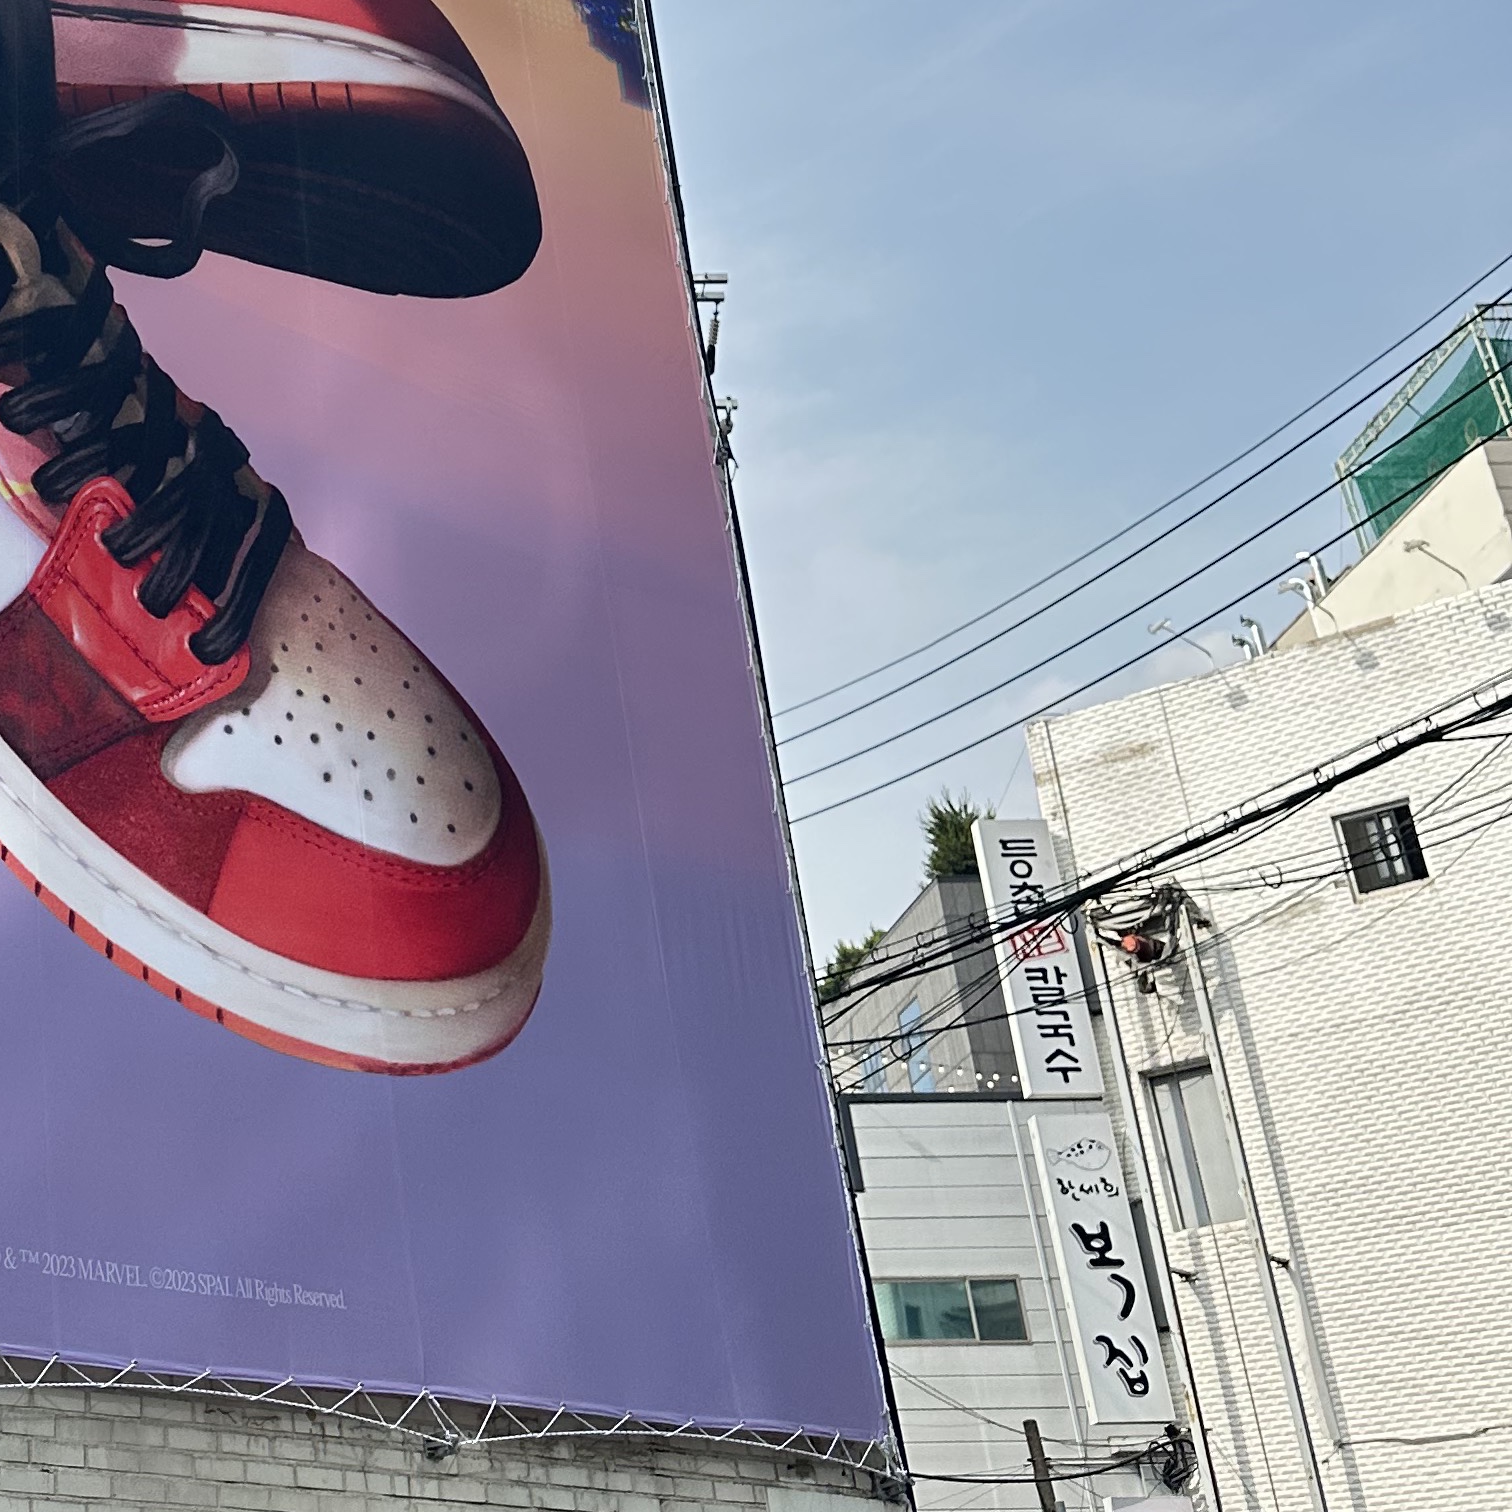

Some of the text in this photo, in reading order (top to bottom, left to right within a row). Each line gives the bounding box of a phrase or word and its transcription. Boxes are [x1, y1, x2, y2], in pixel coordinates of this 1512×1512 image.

[1024, 965, 1082, 1084] 칼국수
[42, 1252, 76, 1278] 2023
[235, 1277, 253, 1298] All
[255, 1279, 292, 1307] Rights
[1070, 1220, 1150, 1397] 복집
